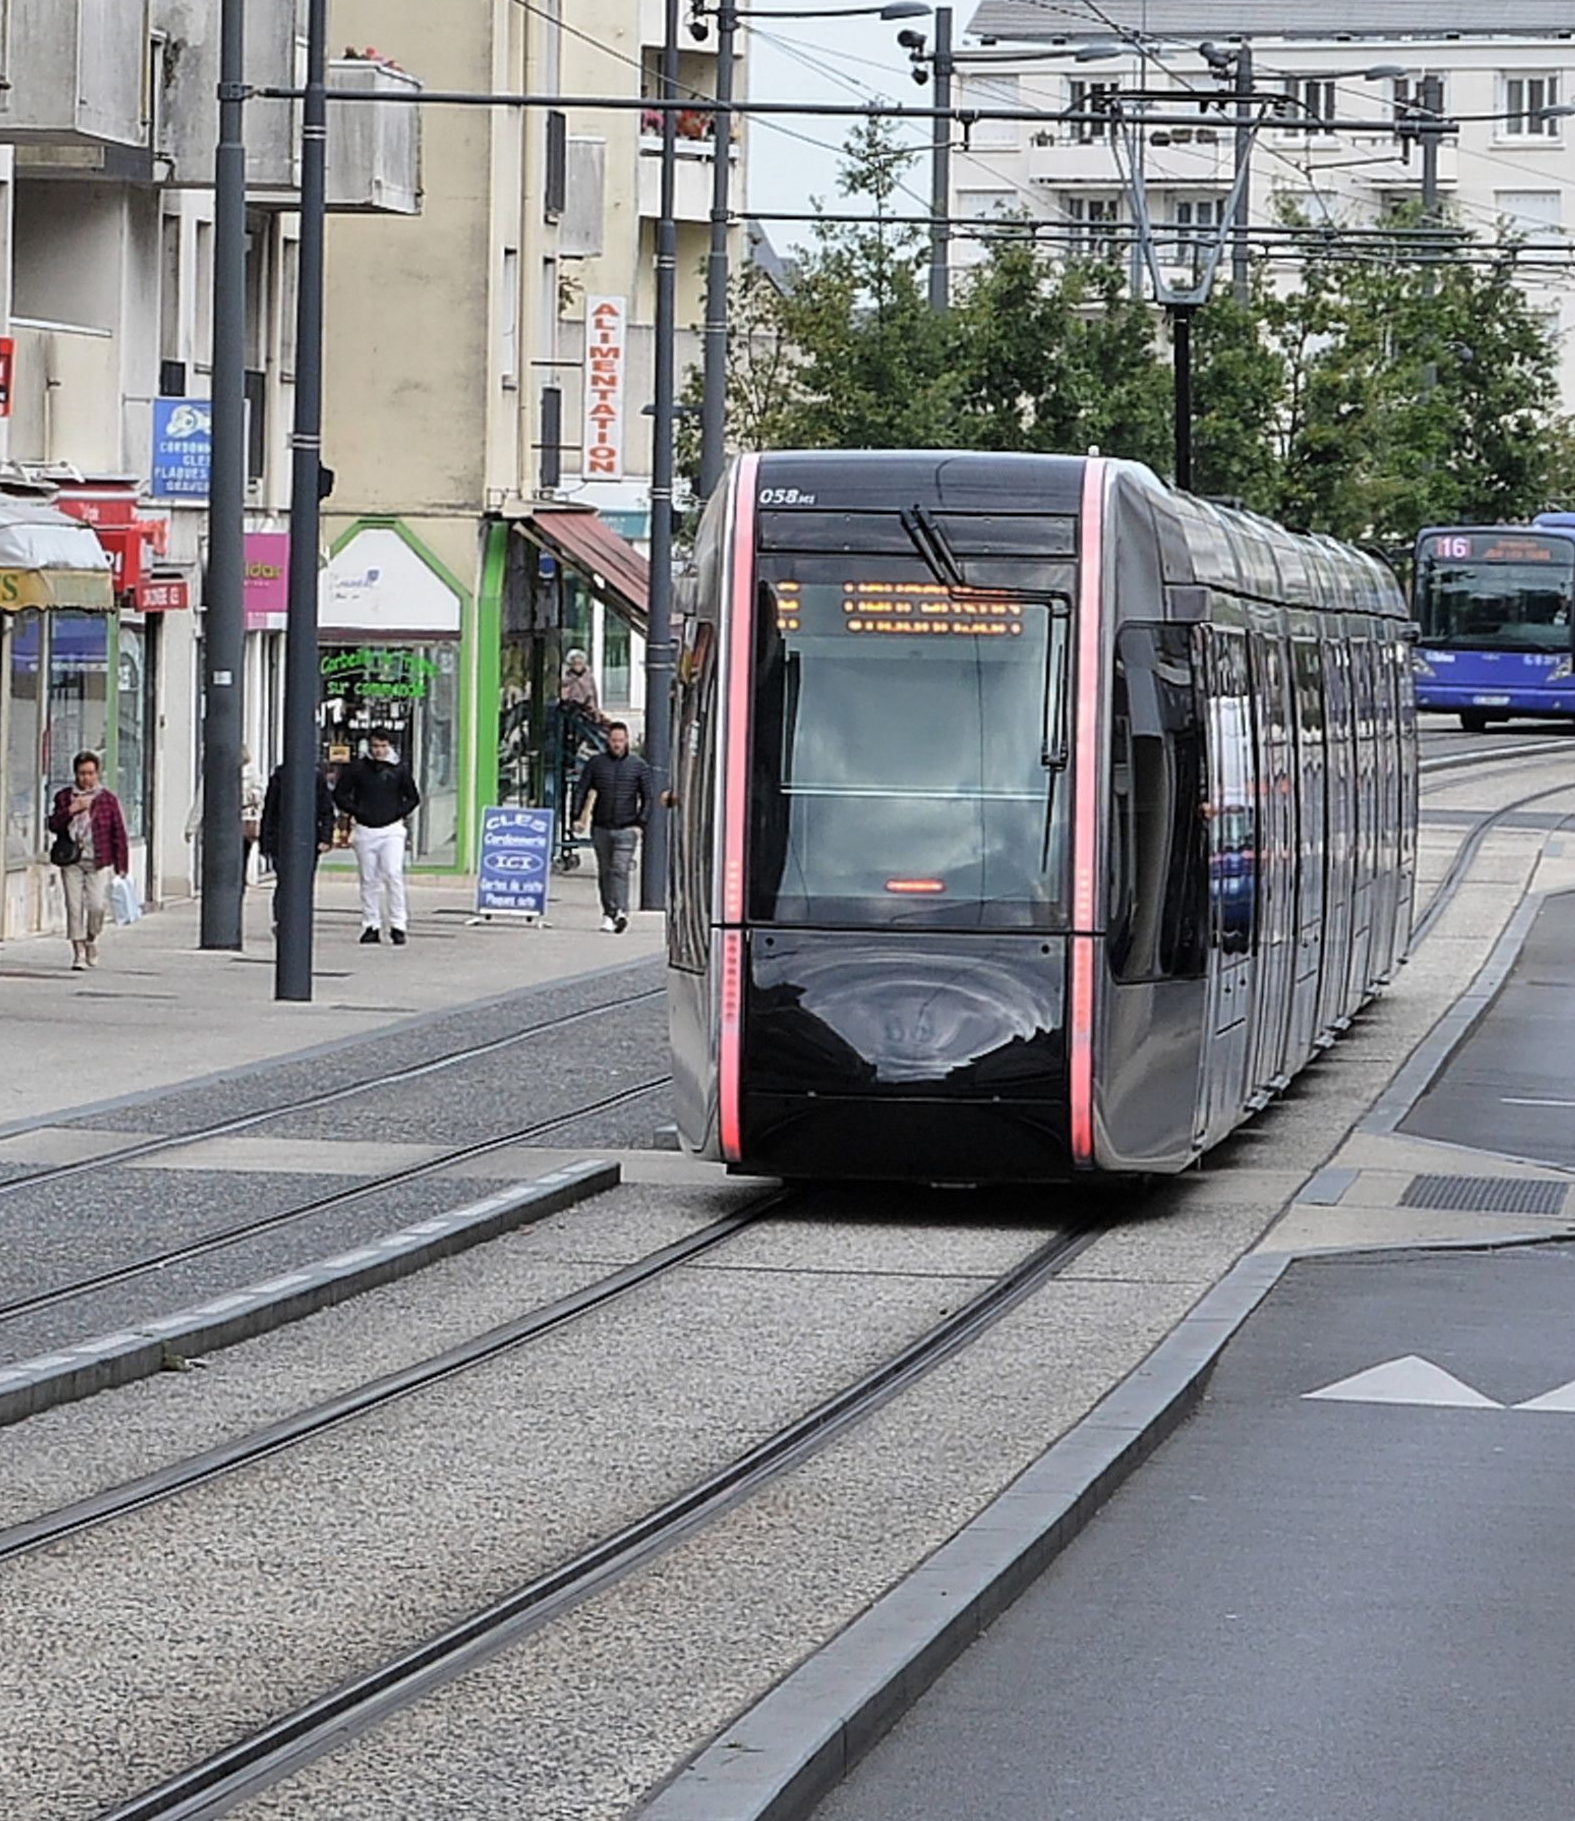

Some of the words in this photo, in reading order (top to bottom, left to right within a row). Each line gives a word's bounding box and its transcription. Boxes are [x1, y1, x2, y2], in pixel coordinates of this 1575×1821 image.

[589, 302, 620, 473] ALIMENTATION
[760, 488, 799, 504] 058
[1441, 537, 1468, 558] 16
[497, 856, 532, 869] ICI
